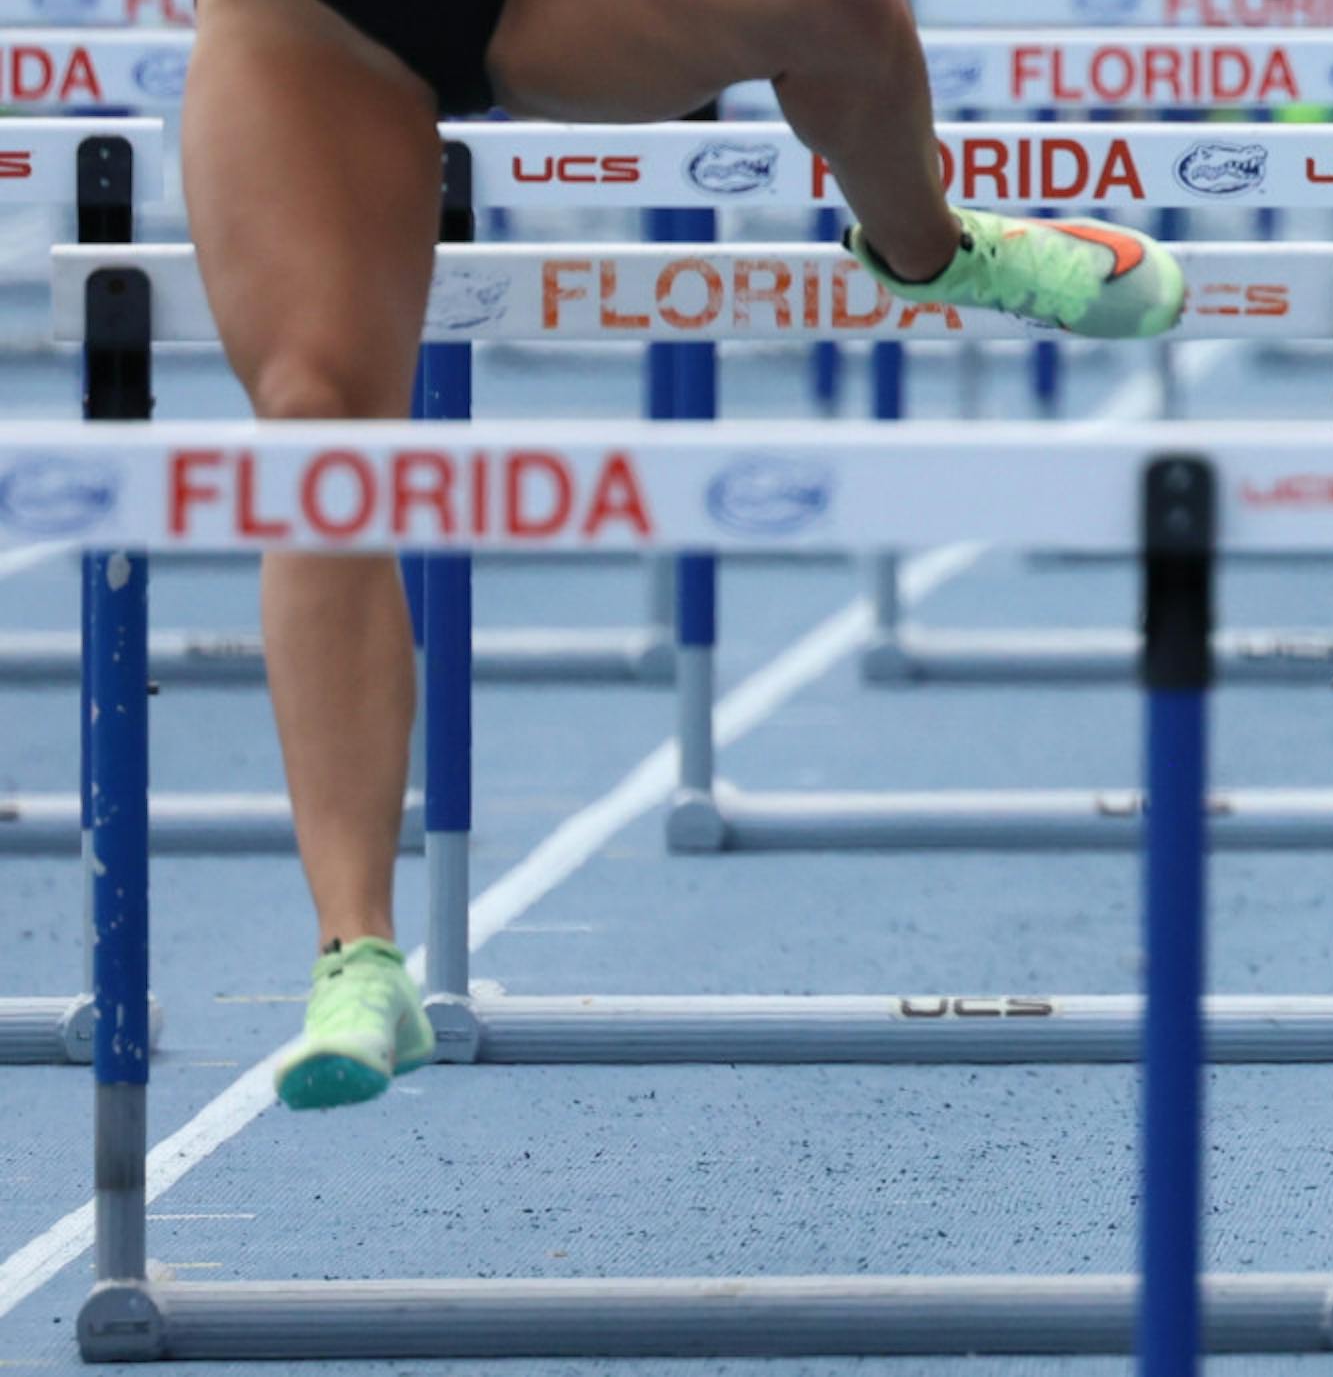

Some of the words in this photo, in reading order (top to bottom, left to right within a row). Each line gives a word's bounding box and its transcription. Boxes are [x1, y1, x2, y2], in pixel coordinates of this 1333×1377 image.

[1012, 48, 1299, 101] FLORIDA
[513, 156, 640, 183] UCS
[1184, 284, 1290, 316] CS
[168, 451, 653, 540] FLORIDA
[902, 998, 1052, 1018] UCS
